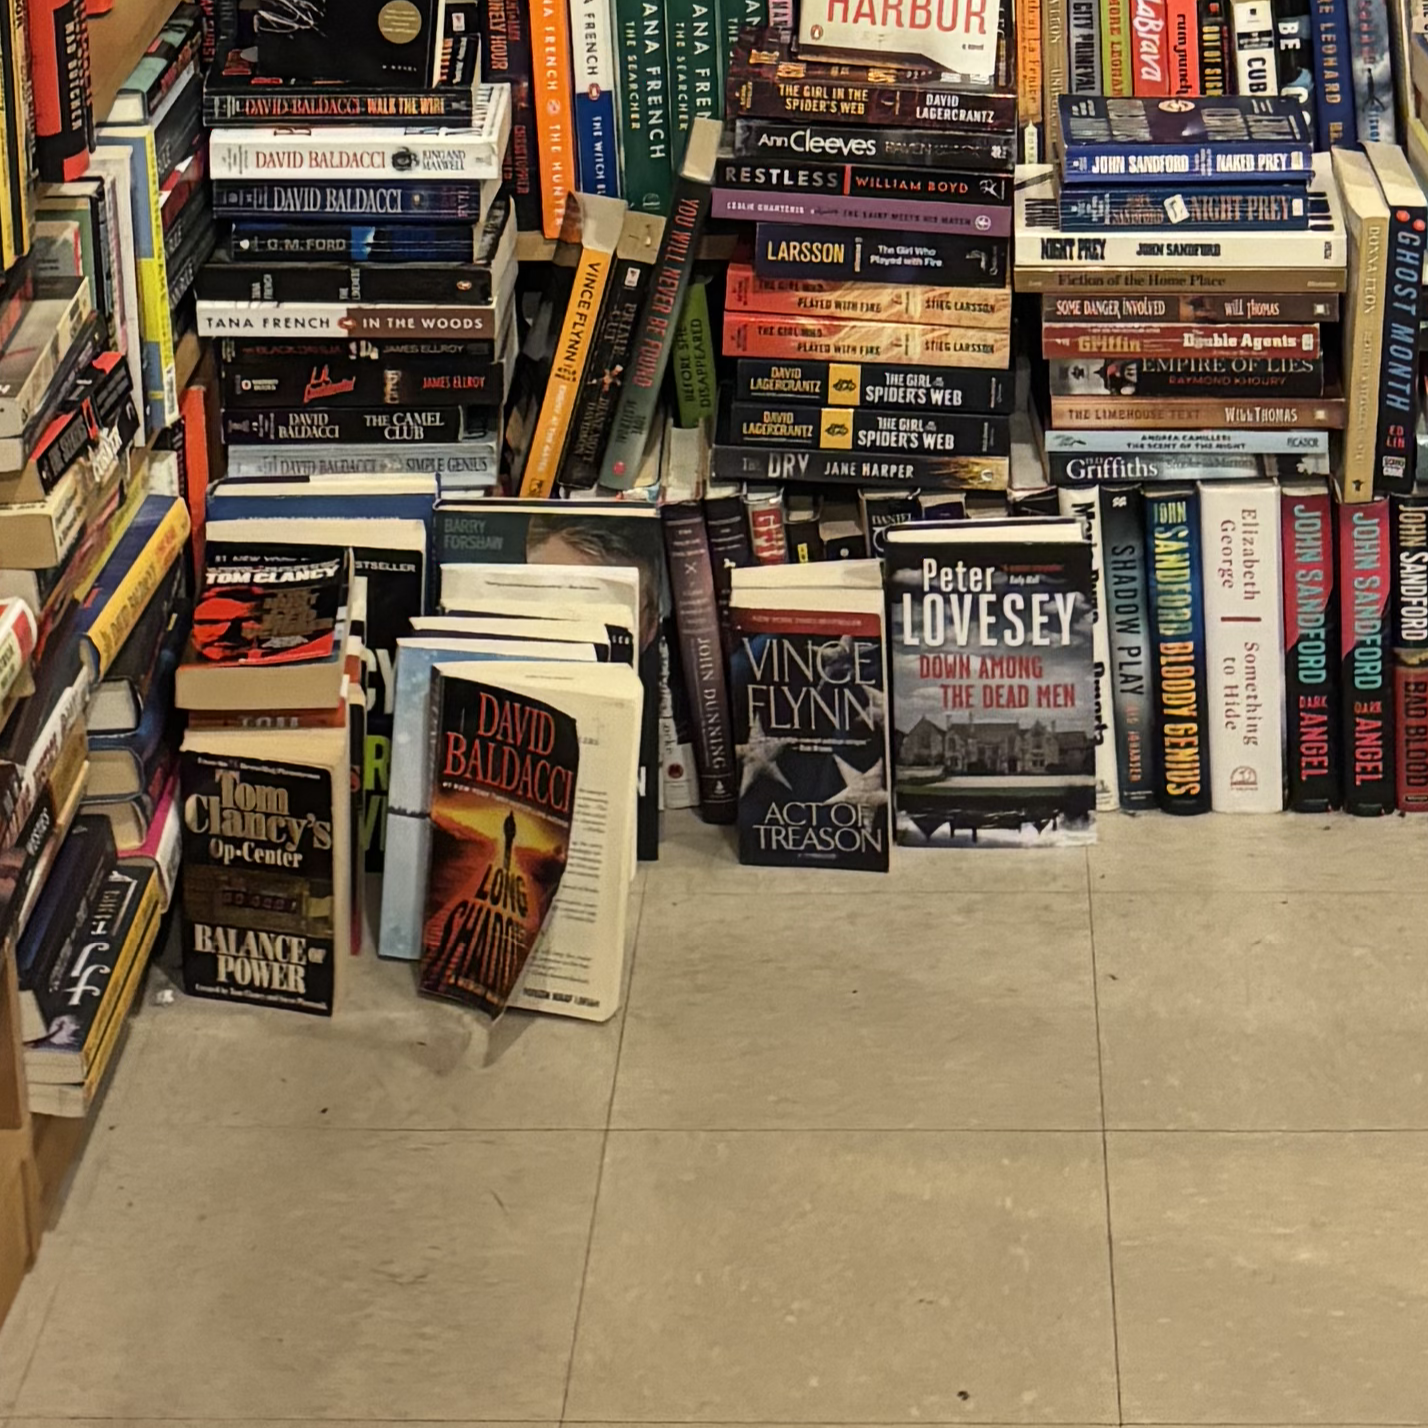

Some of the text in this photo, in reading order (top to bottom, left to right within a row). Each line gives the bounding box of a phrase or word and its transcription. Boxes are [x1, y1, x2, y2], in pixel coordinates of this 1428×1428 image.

[926, 93, 960, 107] DAVID
[915, 106, 994, 122] LAGERCRANTZ
[790, 129, 876, 156] Cleeves
[254, 151, 385, 170] DAVID BALDACCI
[725, 166, 839, 188] RESTLESS
[855, 176, 968, 194] WILLIAM BOYD
[767, 242, 845, 263] LARSSON
[205, 315, 330, 330] TANA FRENCH
[362, 316, 483, 329] IN THE WOODS
[865, 386, 962, 407] SPIDER'S WEB
[1066, 454, 1158, 480] Griffiths
[923, 558, 995, 592] Peter
[902, 593, 1075, 647] LOVESEY
[742, 637, 876, 685] VINCE
[920, 655, 1042, 679] DOWN AMONG
[748, 684, 876, 731] FLYNN
[940, 684, 1075, 709] THE DEAD MEN
[479, 692, 555, 756] DAVID
[444, 731, 573, 813] BALDACCI
[214, 769, 290, 814] Tom
[185, 794, 332, 849] Clancy's
[763, 802, 819, 826] ACT
[752, 825, 881, 852] TREASON
[194, 923, 307, 966] BALANCE
[217, 954, 306, 993] POWER
